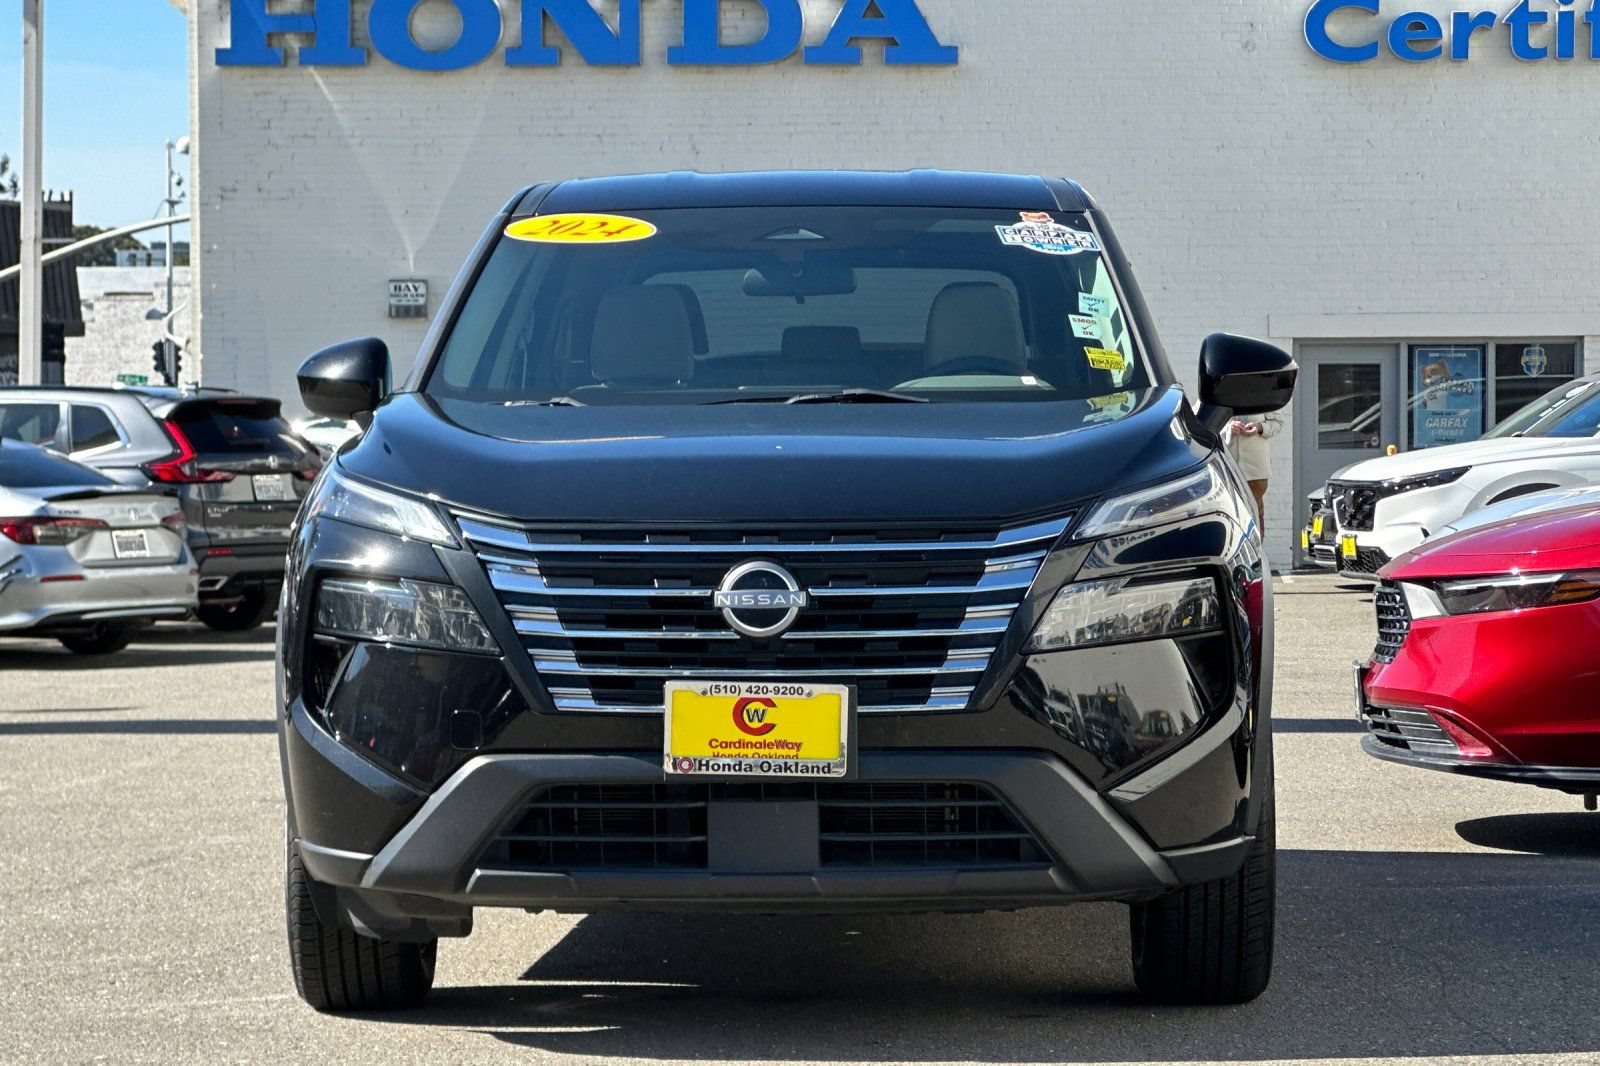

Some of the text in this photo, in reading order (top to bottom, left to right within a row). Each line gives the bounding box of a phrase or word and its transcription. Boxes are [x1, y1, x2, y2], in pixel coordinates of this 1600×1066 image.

[215, 0, 958, 71] HONDA
[519, 220, 639, 237] 2024
[393, 284, 421, 292] BAY
[1072, 317, 1097, 325] SMOG
[1425, 417, 1469, 428] CARFAX
[717, 593, 805, 606] NISSAN
[709, 684, 804, 697] (510) 420-9200
[708, 738, 803, 752] CardinaleWay
[698, 759, 832, 775] Honda Oakland
